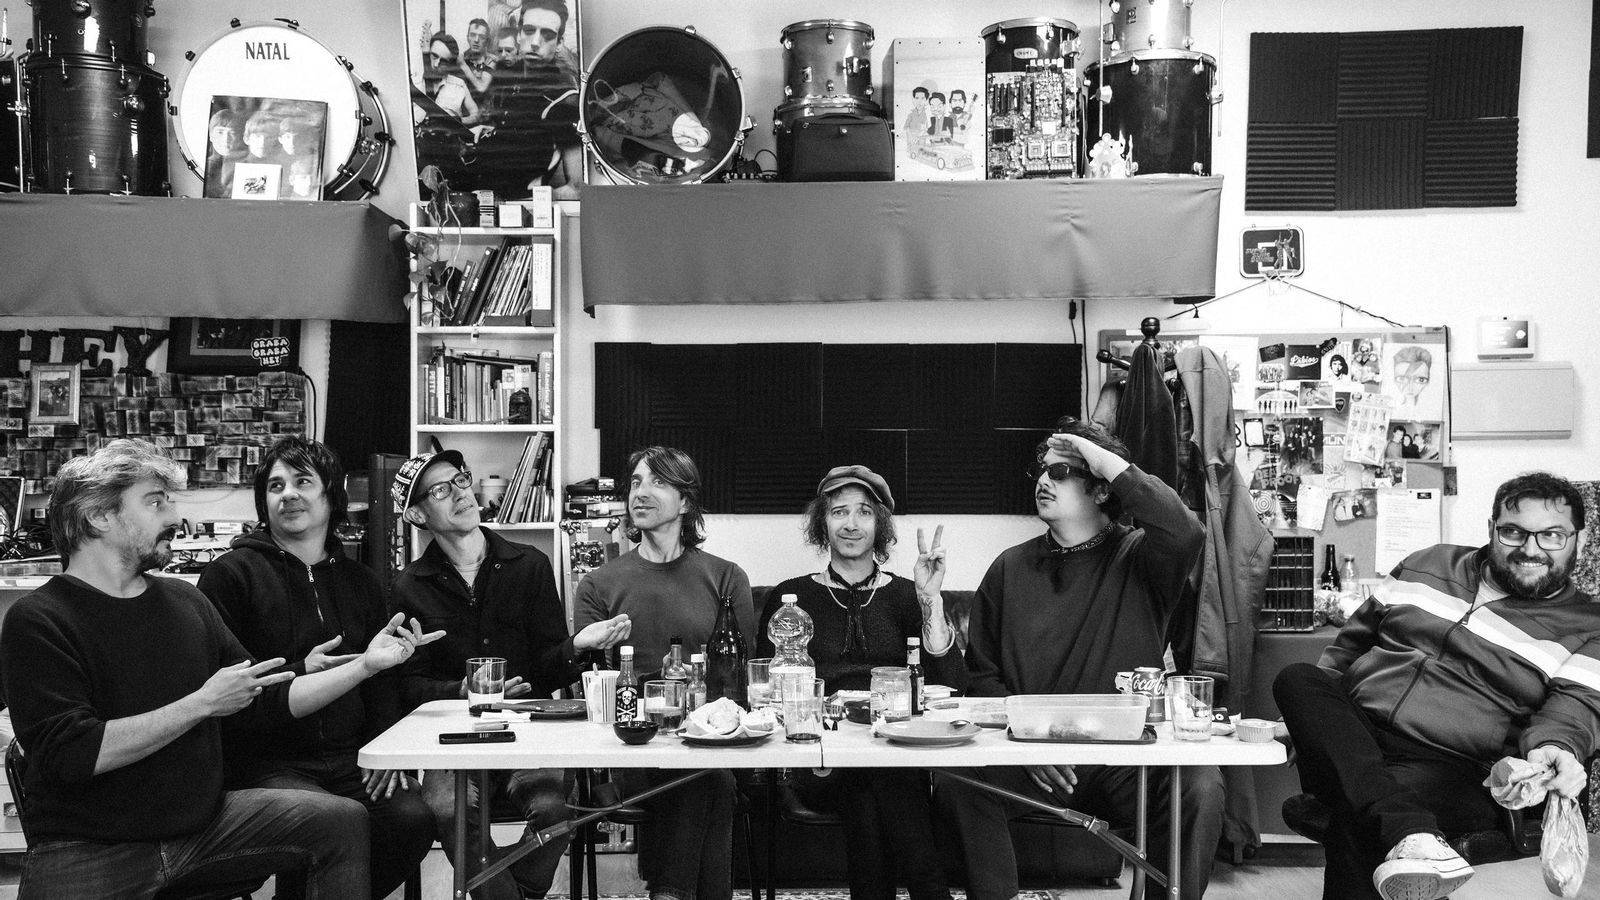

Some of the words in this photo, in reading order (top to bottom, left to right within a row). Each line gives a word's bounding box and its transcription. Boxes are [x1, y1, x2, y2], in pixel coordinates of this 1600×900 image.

[245, 41, 290, 60] NATAL
[0, 326, 170, 378] HEY
[1262, 474, 1300, 489] PROOF
